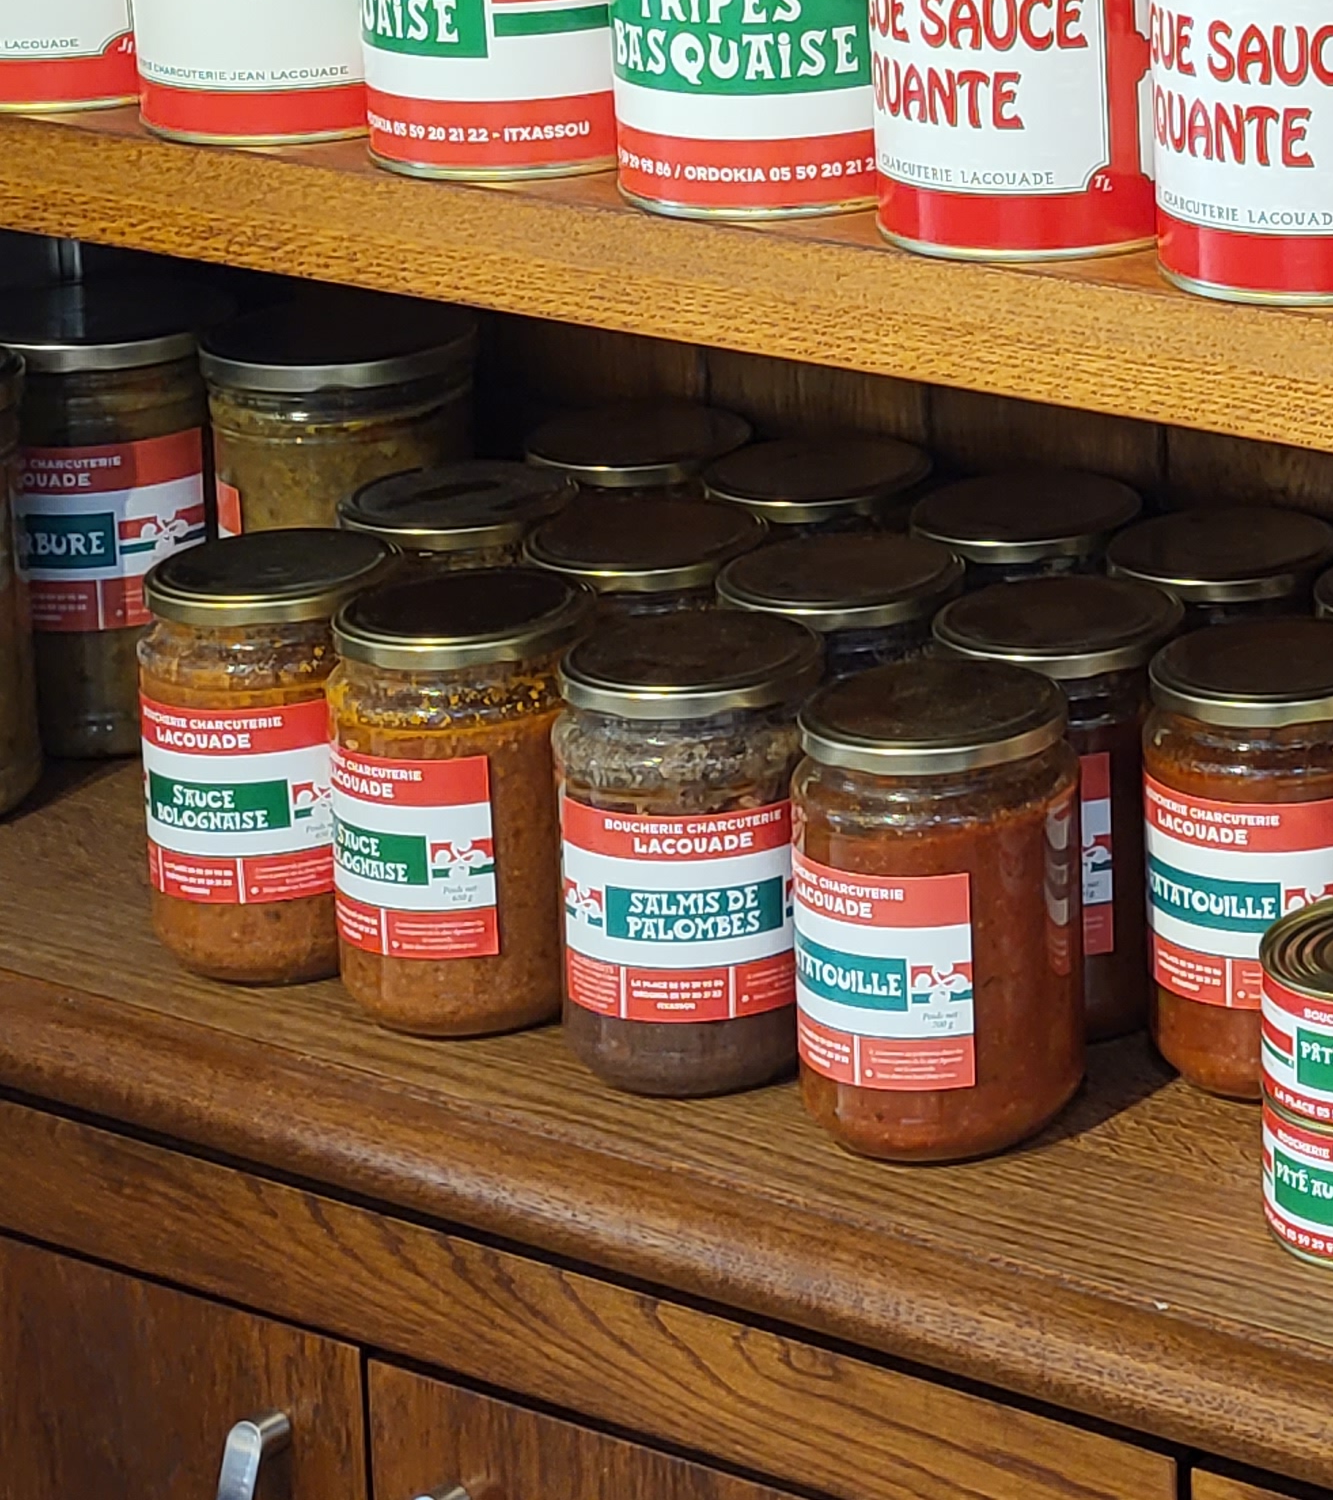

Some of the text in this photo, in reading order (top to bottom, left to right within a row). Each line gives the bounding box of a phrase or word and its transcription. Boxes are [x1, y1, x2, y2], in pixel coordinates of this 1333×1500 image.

[4, 38, 79, 50] LACOUADE
[230, 69, 266, 82] JEAN
[270, 65, 349, 81] LACOUADE
[409, 119, 591, 142] 59 20 21 22 ITXASSOU
[960, 170, 1055, 187] LACOUADE
[189, 716, 283, 730] CHARCUTERIE
[156, 726, 252, 749] LACOUADE
[172, 784, 235, 808] SAUCE
[604, 809, 782, 834] BOUCHERIE CHARCUTERIE
[1157, 809, 1248, 845] LACOUADE
[1190, 808, 1280, 826] CHARCUTERIE
[634, 832, 753, 855] LACOUADE
[727, 885, 758, 911] DE
[626, 910, 761, 940] PALOMBES
